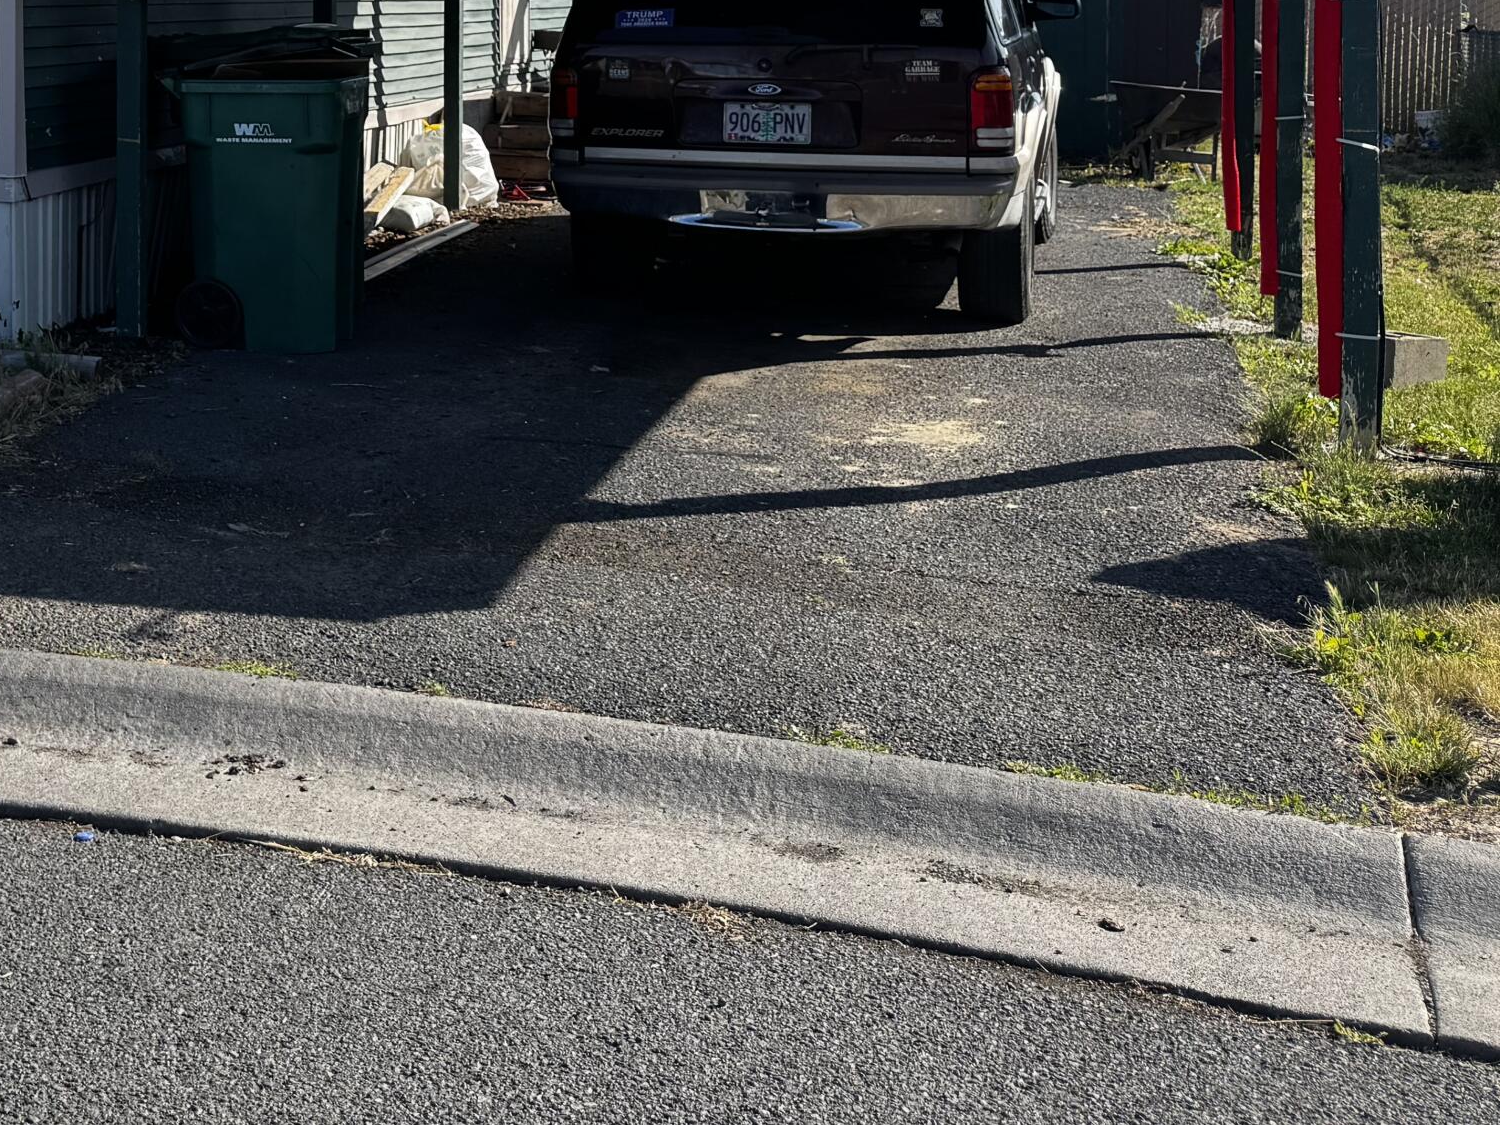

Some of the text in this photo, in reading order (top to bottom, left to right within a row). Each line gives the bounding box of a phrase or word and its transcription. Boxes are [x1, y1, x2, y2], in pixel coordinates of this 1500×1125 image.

[626, 10, 664, 19] TRUMP
[233, 122, 272, 136] WM
[728, 112, 806, 134] 906 PNV
[590, 127, 665, 137] EXPLORER
